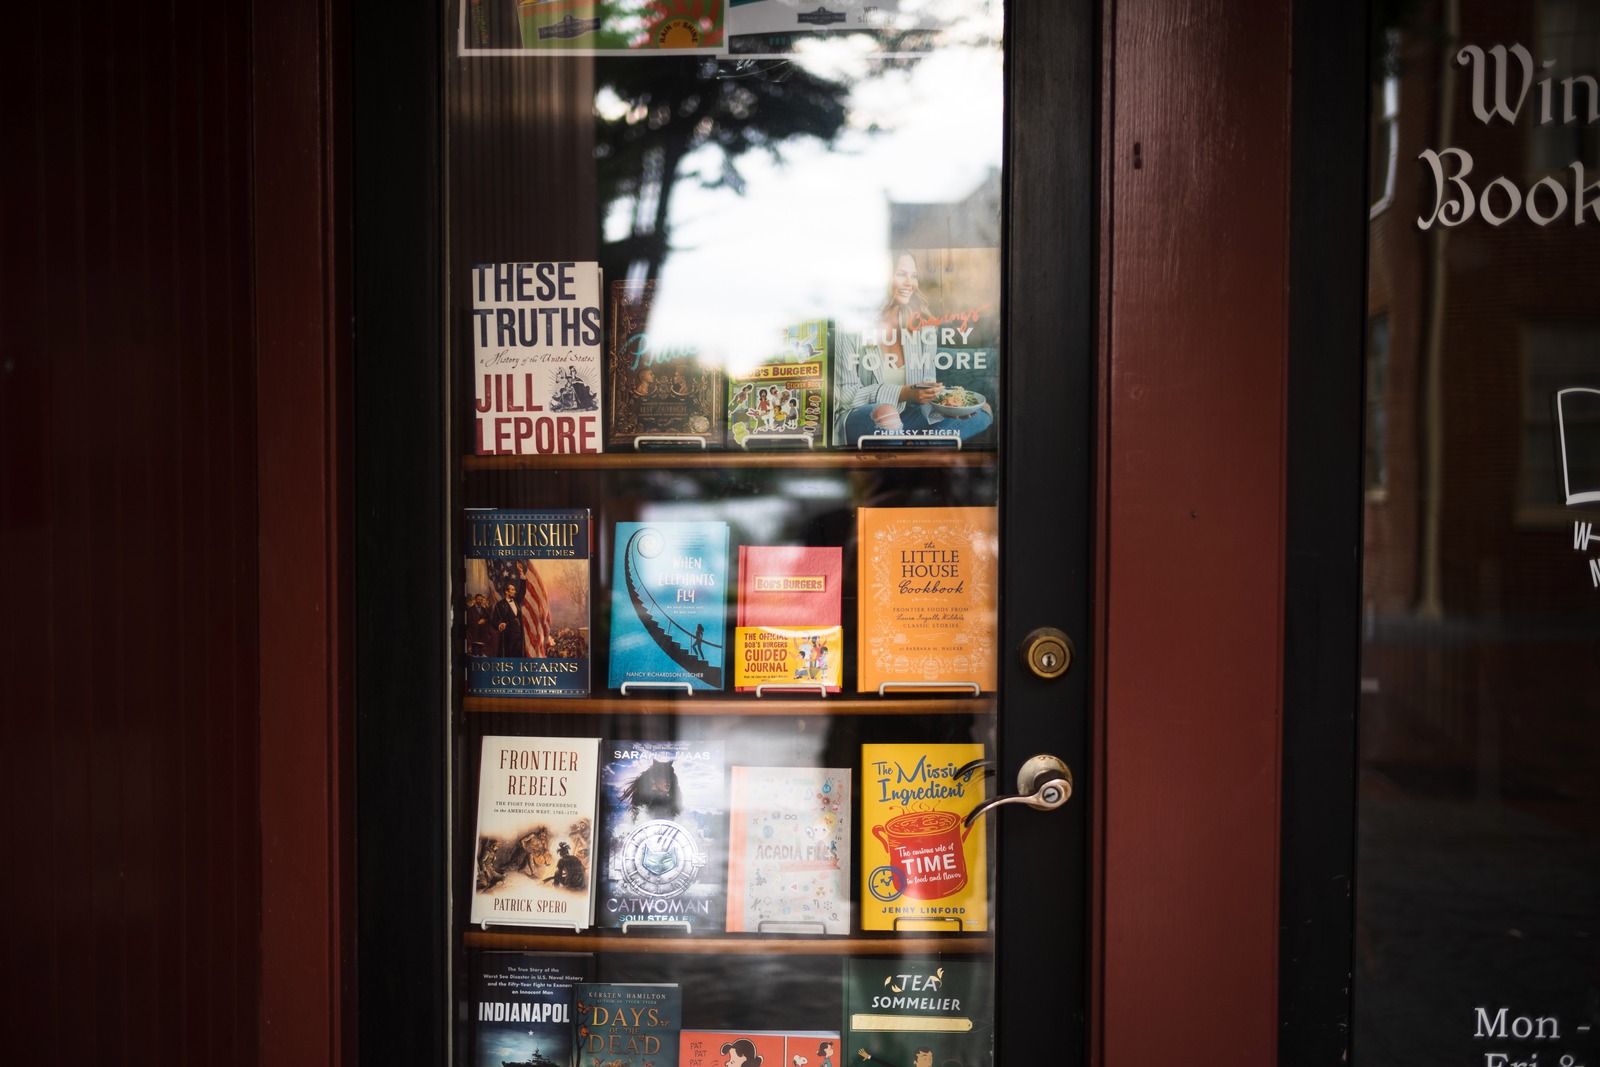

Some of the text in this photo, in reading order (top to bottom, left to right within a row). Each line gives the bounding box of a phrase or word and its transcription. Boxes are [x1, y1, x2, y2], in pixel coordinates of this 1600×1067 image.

[660, 24, 672, 43] RAIN
[682, 22, 699, 43] SHINE
[472, 262, 576, 302] THESE
[909, 303, 992, 332] Cravings
[473, 306, 600, 348] TRUTHS
[862, 326, 974, 346] HUNGRY
[485, 349, 520, 369] History
[521, 357, 530, 366] of
[530, 355, 538, 363] the
[540, 350, 572, 363] United
[570, 354, 595, 362] States
[847, 352, 987, 371] FOR MORE
[772, 366, 818, 376] BURGERS
[476, 373, 543, 413] JILL
[476, 416, 597, 455] LEPORE
[472, 523, 579, 546] LEADERSHIP
[924, 541, 936, 549] the
[673, 556, 702, 570] WHEN
[901, 550, 960, 564] LITTLE
[658, 571, 715, 586] ELEPHANTS
[901, 564, 959, 578] HOUSE
[757, 579, 823, 590] BOB'S BURGERS
[898, 579, 964, 594] Cookbook
[677, 589, 695, 603] FLY
[744, 632, 757, 641] THE
[745, 649, 788, 662] GUIDED
[471, 661, 578, 673] DORIS KEARNS
[744, 662, 788, 673] JOURNAL
[491, 676, 558, 686] GOODWIN
[500, 749, 578, 772] FRONTIER
[675, 751, 711, 760] MAAS
[871, 755, 975, 783] The Missig
[508, 775, 568, 796] REBELS
[877, 778, 965, 806] Ingredient
[755, 845, 803, 860] ACADIA
[894, 843, 954, 857] The curious role of
[901, 853, 956, 875] TIME
[914, 875, 928, 884] food
[929, 874, 942, 882] and
[943, 872, 961, 881] flavor
[493, 898, 567, 913] PATRICK SPERO
[606, 898, 709, 914] CATWOMAN
[896, 974, 938, 992] TEA
[872, 996, 961, 1011] SOMMELIER
[478, 1002, 570, 1023] INDIANAPOL
[591, 1006, 659, 1027] DAYS
[1474, 1007, 1560, 1038] Mon
[587, 1034, 661, 1055] DEAD
[690, 1042, 703, 1050] PAT
